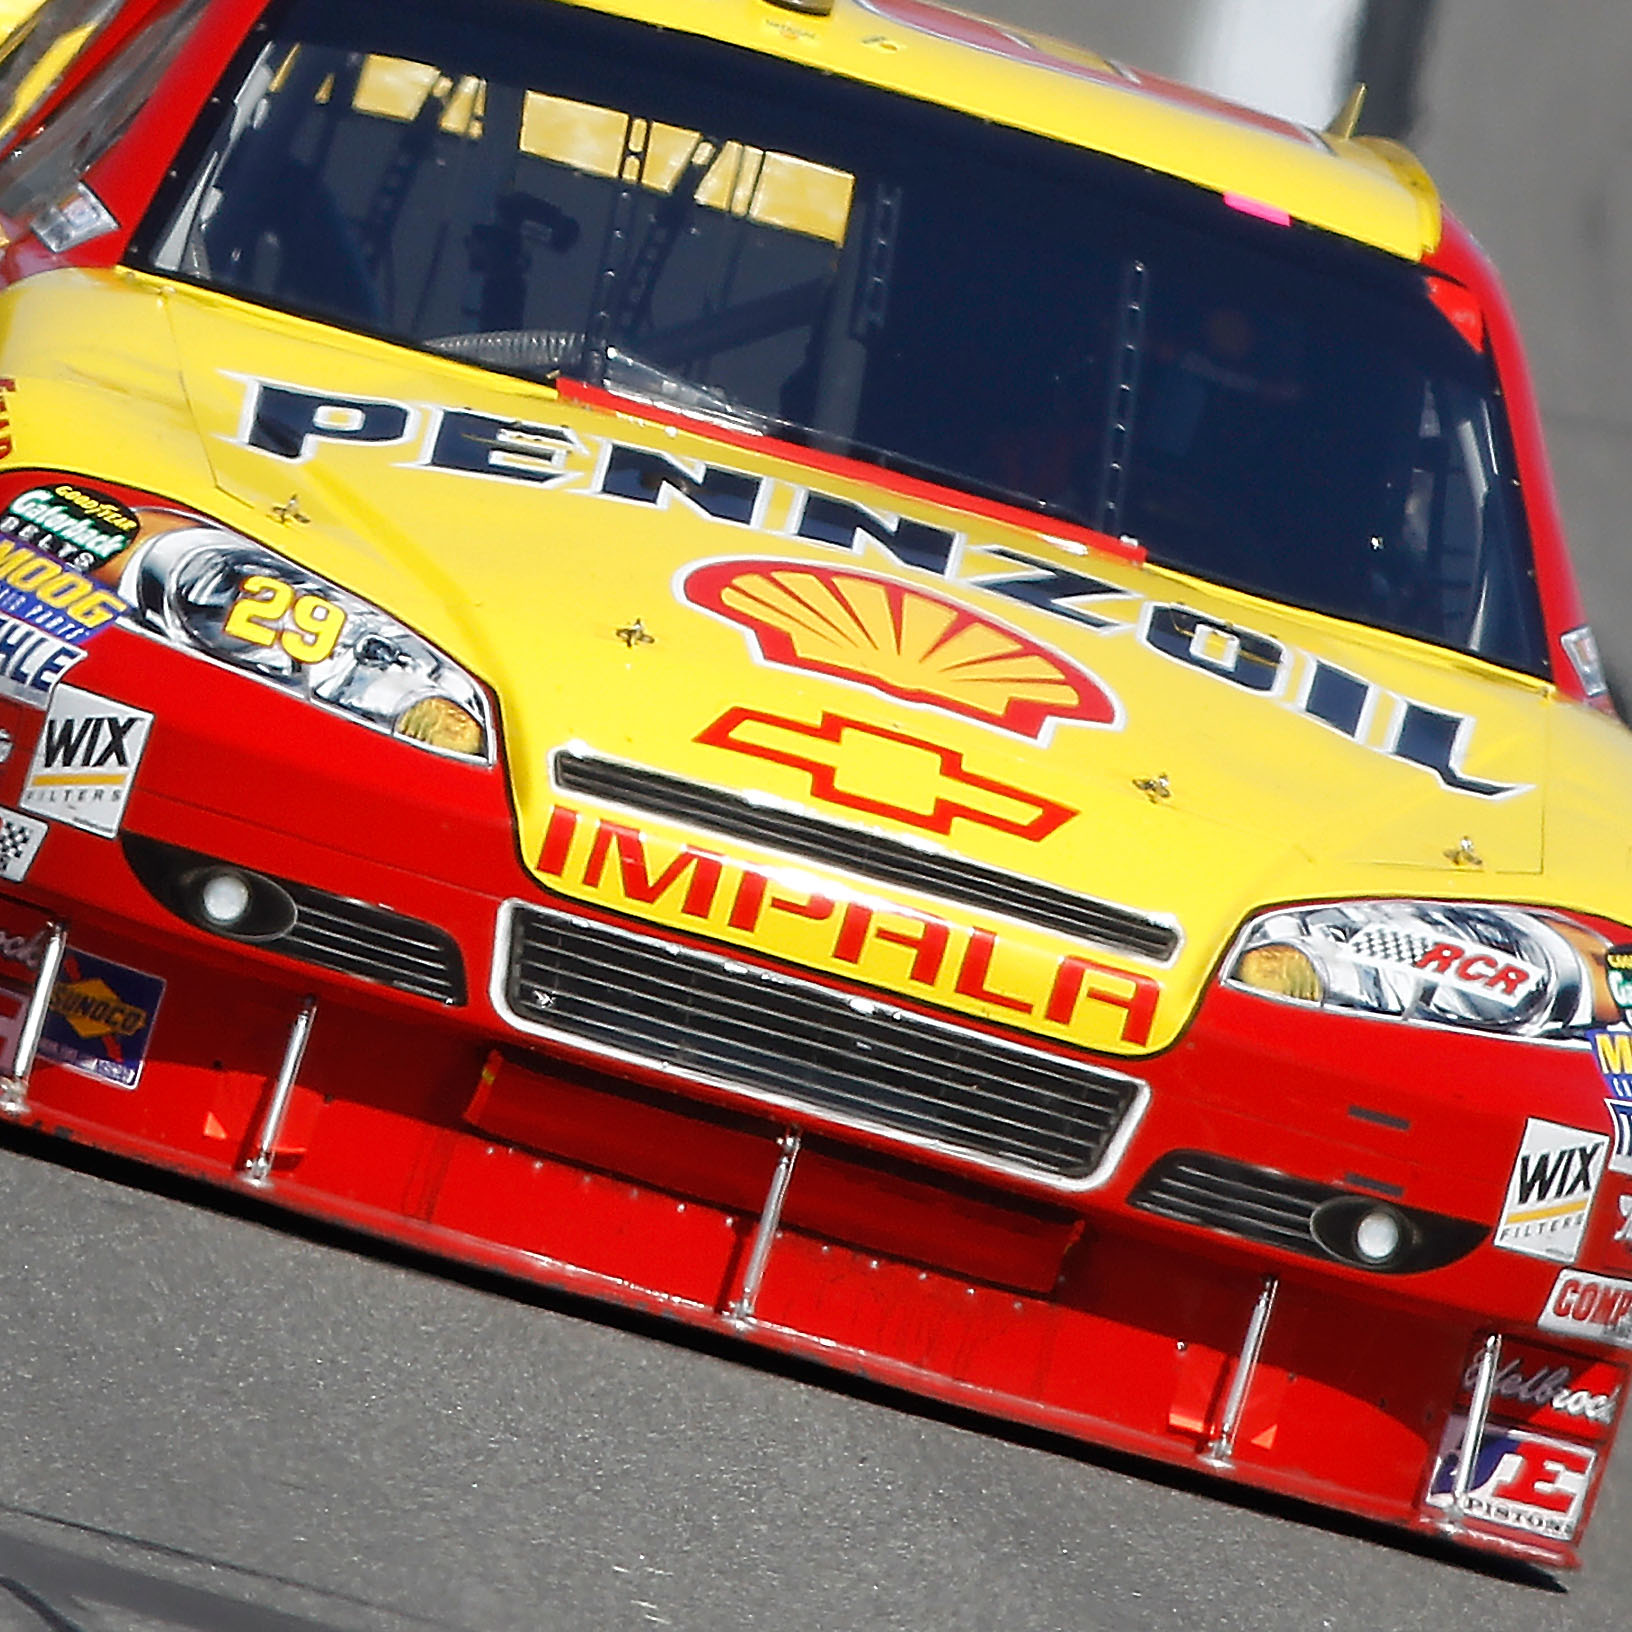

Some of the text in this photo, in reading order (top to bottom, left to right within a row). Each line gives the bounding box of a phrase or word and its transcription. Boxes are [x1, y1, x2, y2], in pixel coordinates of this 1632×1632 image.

[218, 368, 1533, 800] PENNZOIL
[225, 575, 347, 664] 29
[44, 717, 144, 769] WIX
[26, 788, 124, 804] FILTERS
[535, 805, 1161, 1049] IMPALA
[1415, 941, 1531, 997] RCR
[1518, 1141, 1604, 1206] WIX
